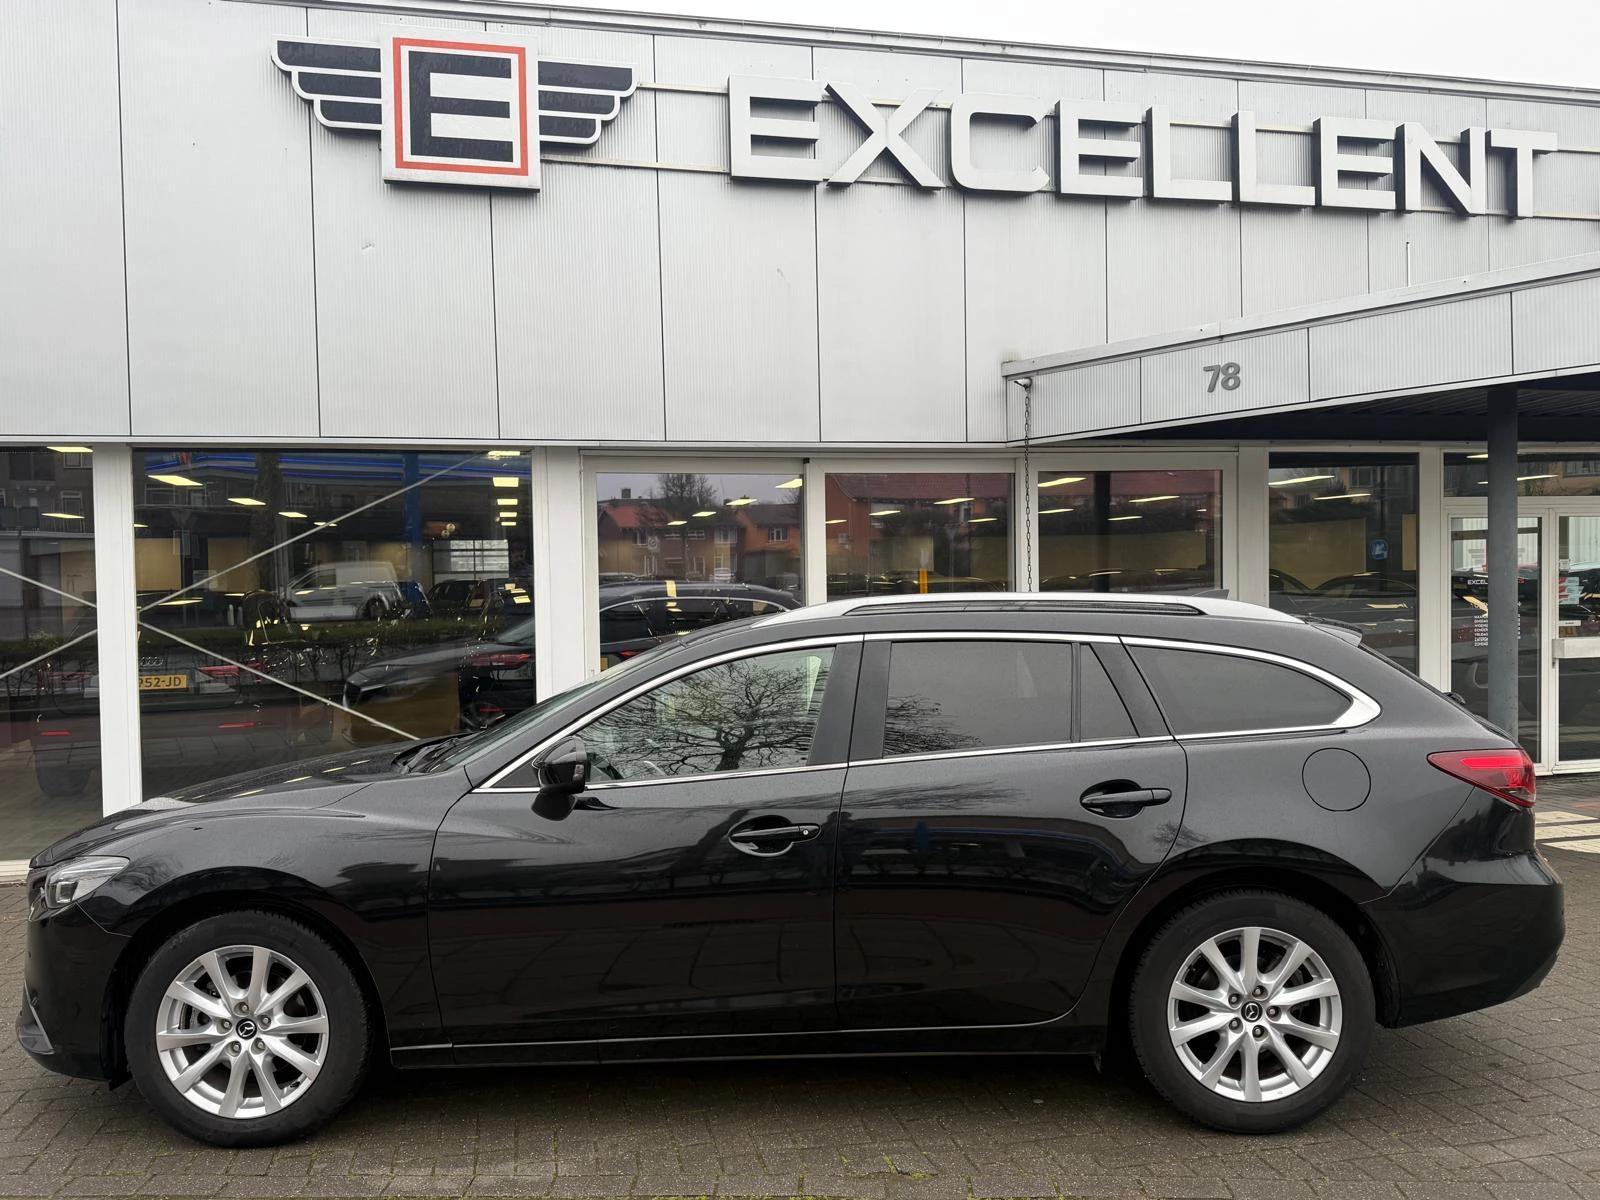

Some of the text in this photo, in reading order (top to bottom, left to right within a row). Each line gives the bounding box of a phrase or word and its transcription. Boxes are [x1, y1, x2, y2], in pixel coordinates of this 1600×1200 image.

[408, 50, 514, 163] E
[728, 74, 1558, 219] EXCELLENT
[1203, 362, 1241, 393] 78
